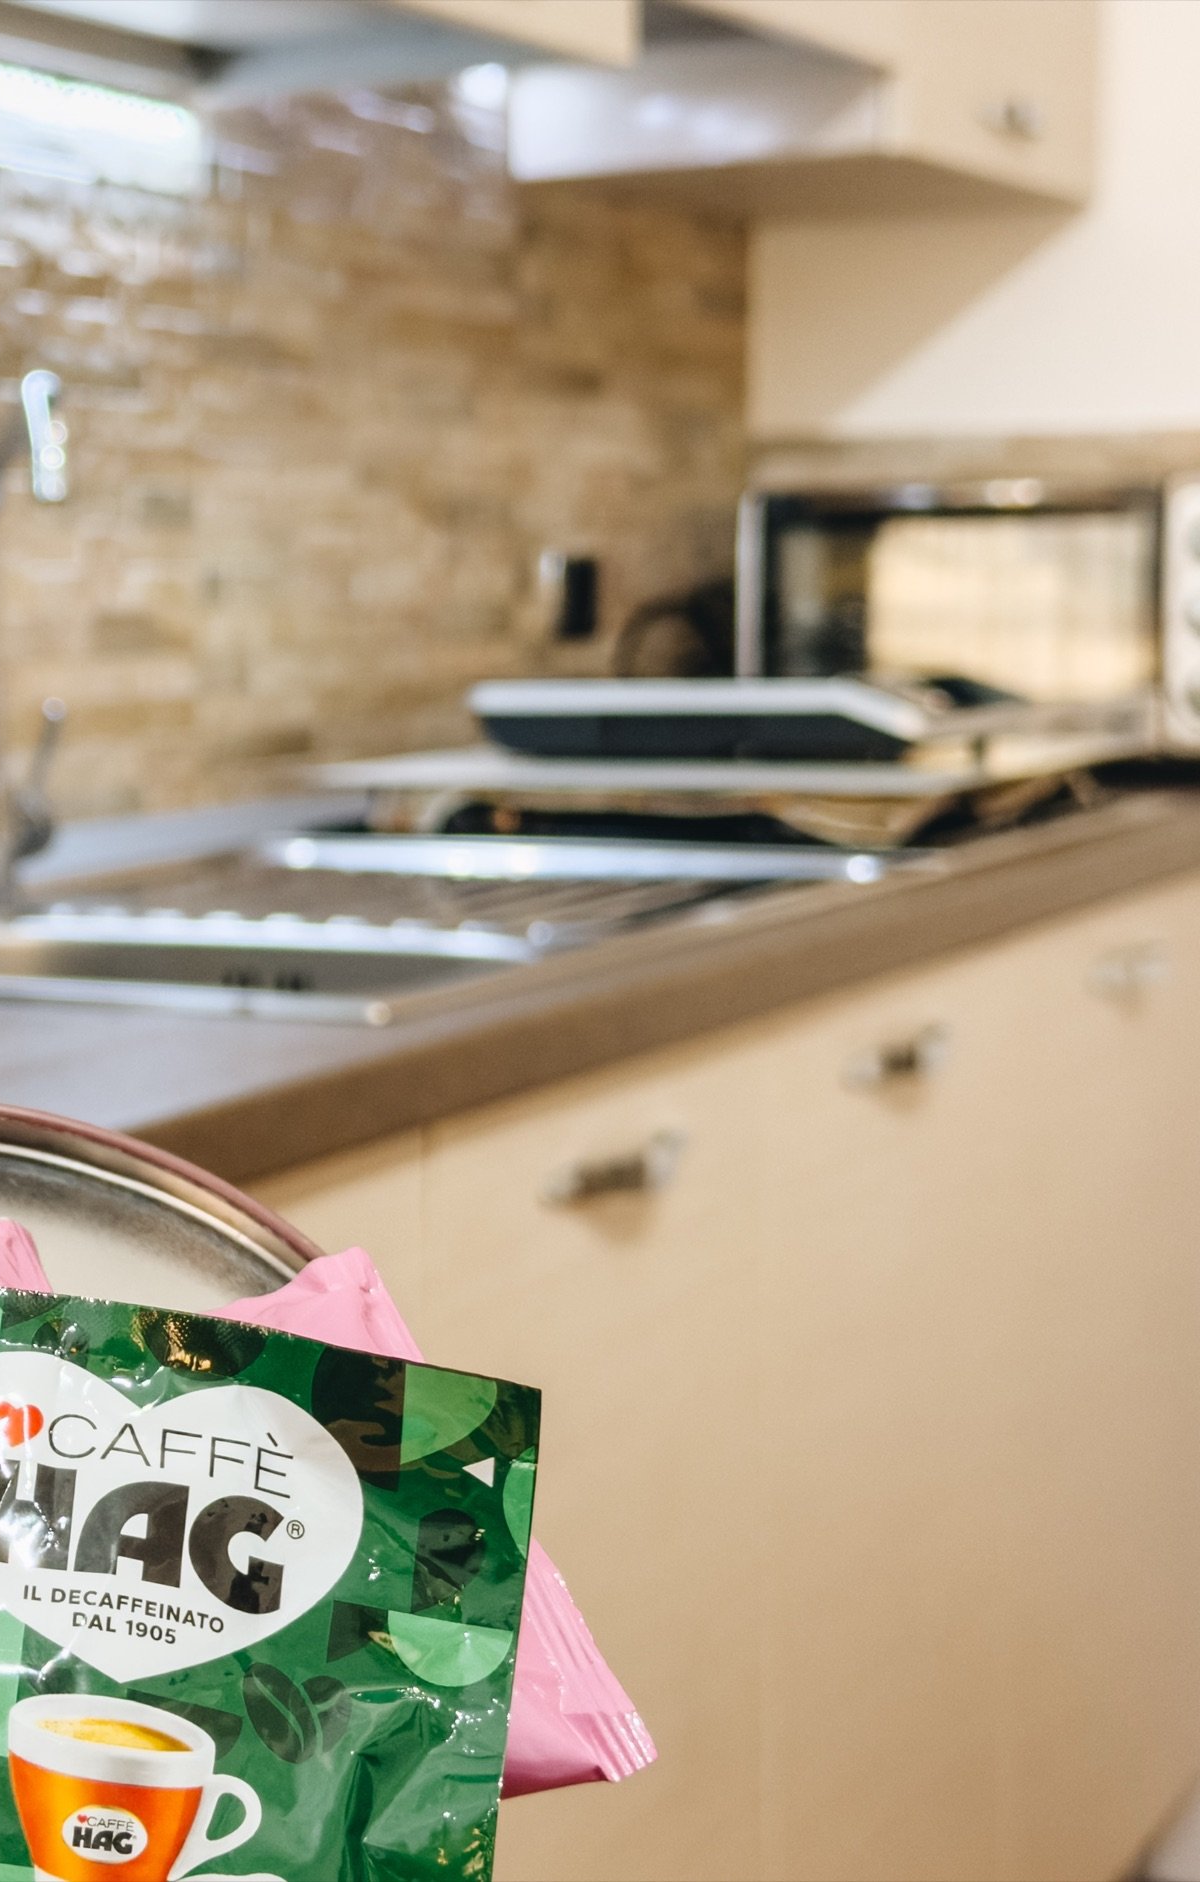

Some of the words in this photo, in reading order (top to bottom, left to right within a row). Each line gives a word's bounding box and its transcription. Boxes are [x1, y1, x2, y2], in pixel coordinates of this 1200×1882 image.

[48, 1413, 294, 1499] CAFFÈ
[23, 1584, 42, 1602] IL
[50, 1587, 225, 1634] DECAFFEINATO
[72, 1611, 117, 1633] DAL
[125, 1619, 177, 1645] 1905
[72, 1826, 133, 1855] HAG
[86, 1816, 135, 1832] CAFFÈ
